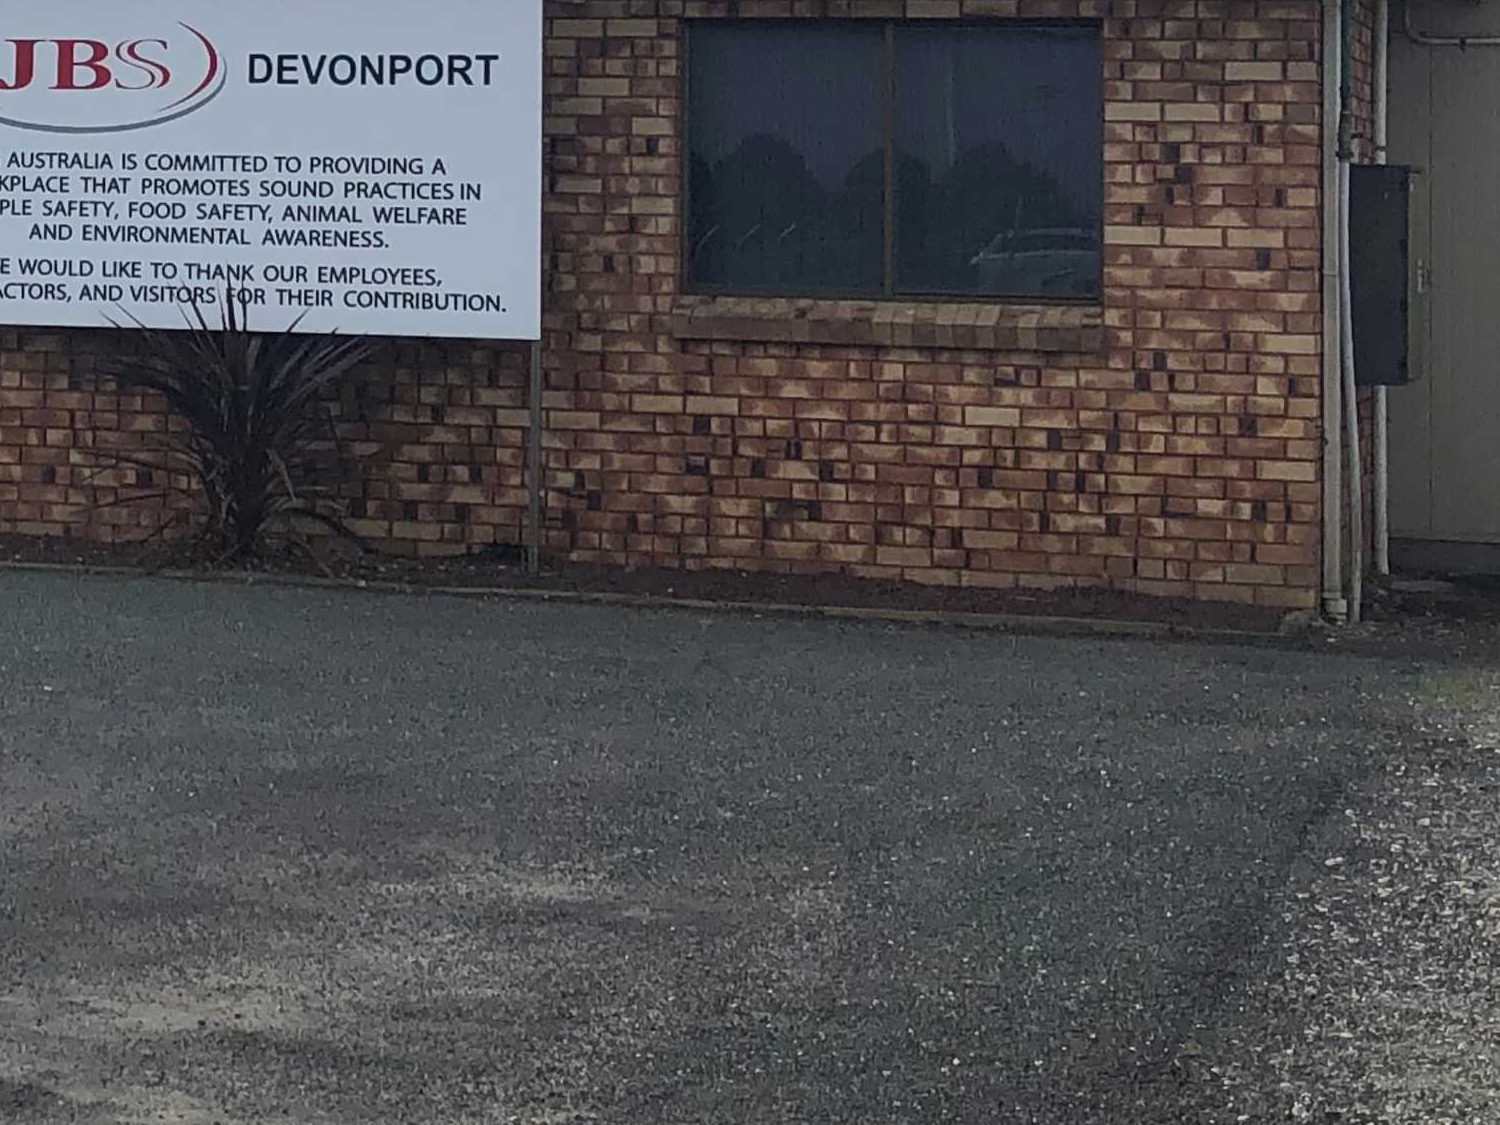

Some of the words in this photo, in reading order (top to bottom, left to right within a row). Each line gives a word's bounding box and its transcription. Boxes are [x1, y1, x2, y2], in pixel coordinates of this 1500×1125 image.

[248, 54, 499, 86] DEVONPORT
[7, 152, 113, 169] AUSTRALIA
[122, 153, 137, 170] IS
[145, 154, 267, 172] COMMITTED
[274, 156, 301, 173] TO
[310, 157, 423, 174] PROVIDING
[432, 159, 446, 175] A
[80, 177, 131, 193] THAT
[142, 178, 250, 196] PROMOTES
[259, 180, 333, 198] SOUND
[344, 182, 454, 200] PRACTICES
[461, 184, 481, 200] IN
[43, 200, 118, 219] SAFETY,
[129, 202, 186, 219] FOOD
[197, 203, 272, 223] SAFETY,
[282, 205, 362, 223] ANIMAL
[373, 207, 466, 225] WELFARE
[29, 224, 72, 240] AND
[82, 225, 251, 244] ENVIRONMENTAL
[262, 229, 388, 247] AWARENESS.
[19, 259, 93, 276] WOULD
[103, 261, 141, 278] LIKE
[150, 263, 177, 279] TO
[185, 263, 254, 281] THANK
[263, 265, 307, 282] OUR
[318, 267, 442, 286] EMPLOYEES,
[79, 284, 123, 301] AND
[130, 285, 216, 304] VISITORS
[226, 286, 265, 306] FOR
[276, 289, 332, 306] THEIR
[344, 291, 506, 312] CONTRIBUTION.
